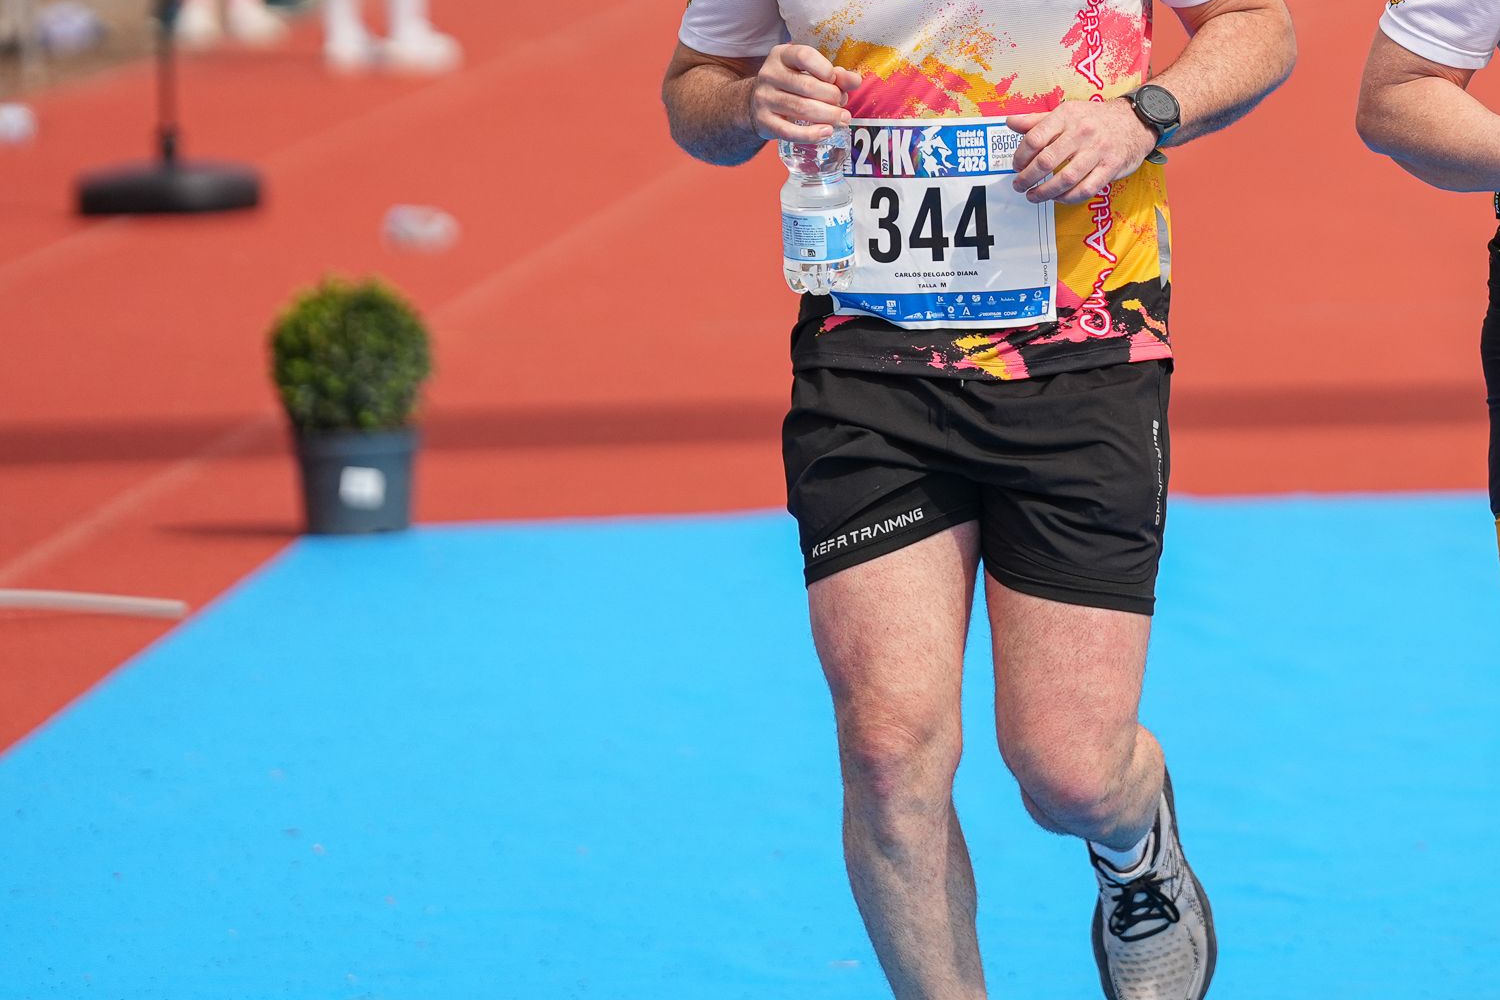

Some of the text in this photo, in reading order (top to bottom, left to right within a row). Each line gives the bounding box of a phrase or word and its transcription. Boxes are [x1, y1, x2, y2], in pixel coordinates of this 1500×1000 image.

[957, 137, 985, 148] LUCENA
[991, 133, 1025, 144] carrera
[854, 127, 916, 175] 21K
[957, 156, 988, 172] 2026
[868, 185, 995, 263] 344
